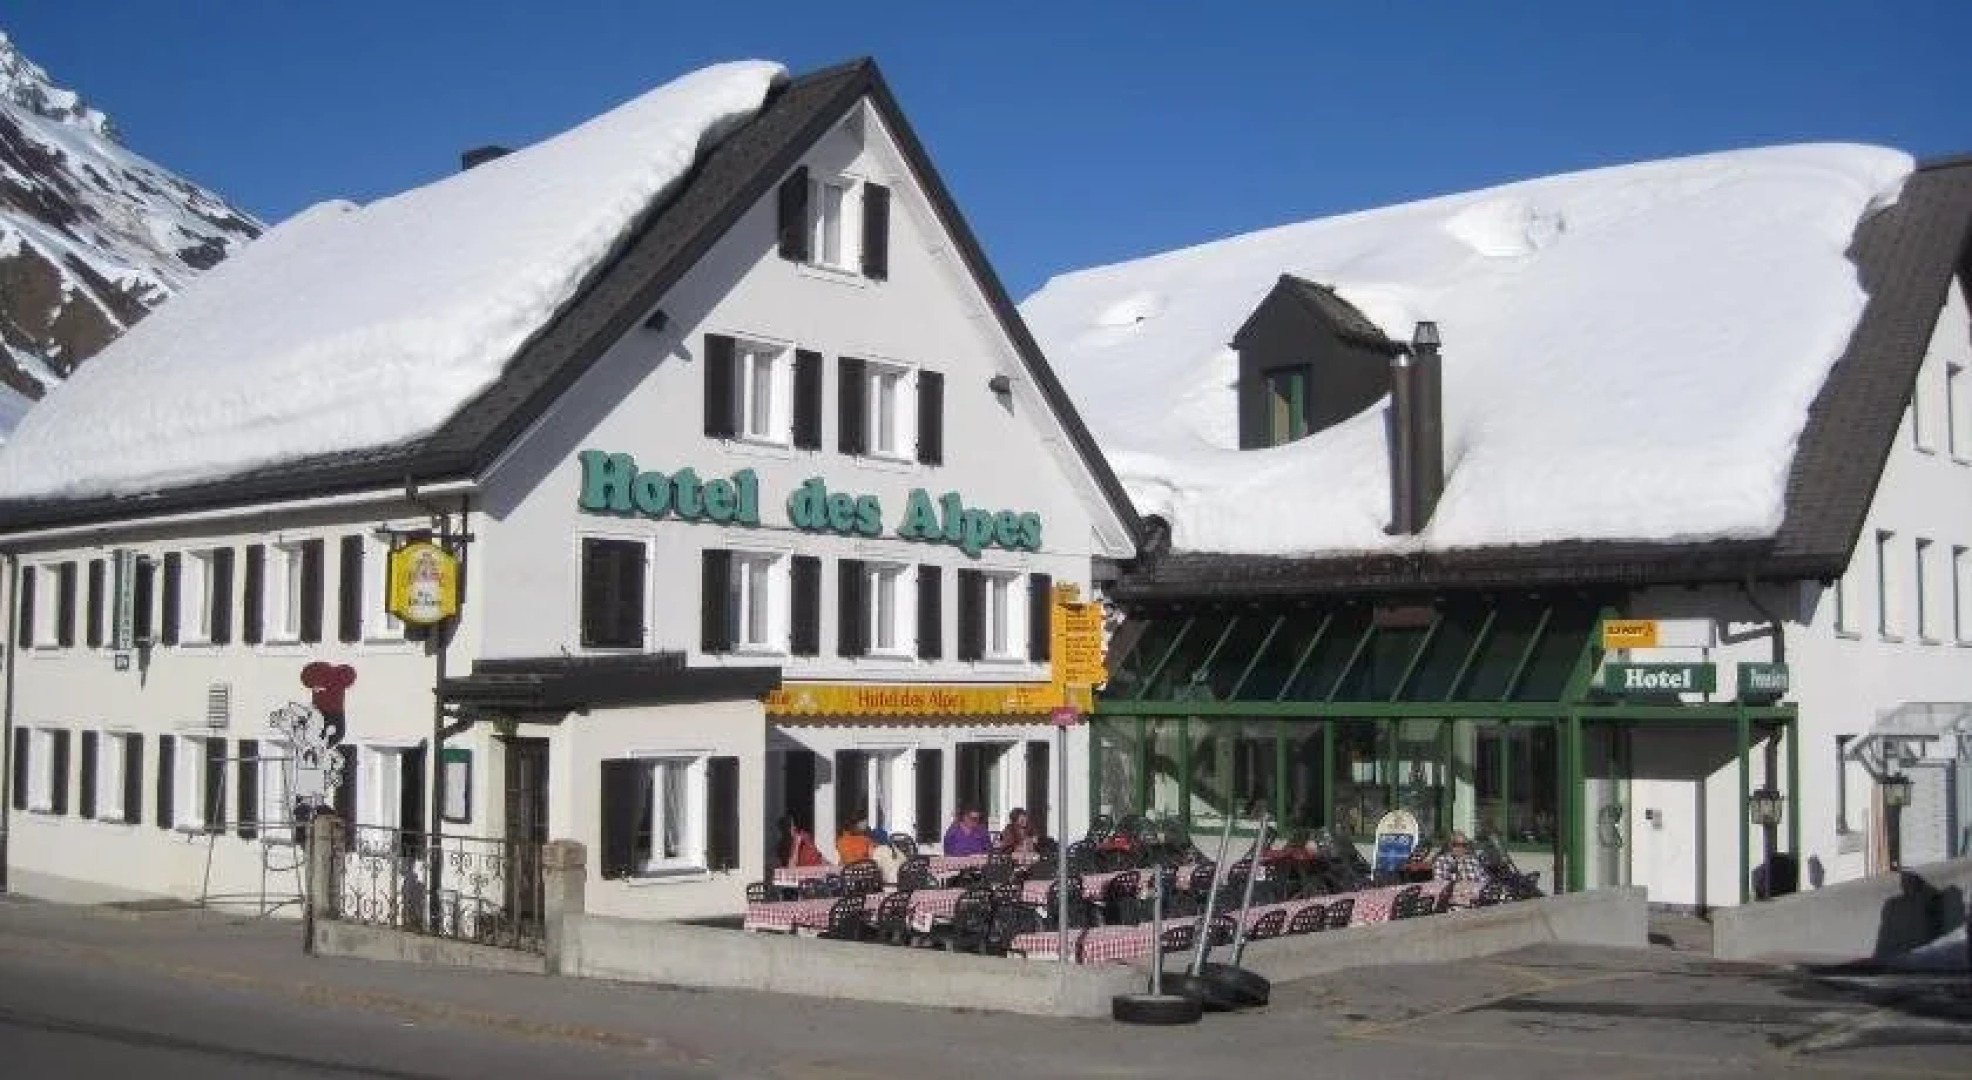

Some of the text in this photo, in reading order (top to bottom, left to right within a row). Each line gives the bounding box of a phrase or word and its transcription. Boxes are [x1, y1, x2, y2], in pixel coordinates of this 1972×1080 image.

[578, 449, 1043, 559] Hotel des Alpes
[1624, 668, 1692, 689] Hotel
[857, 688, 898, 708] Hotel
[900, 689, 926, 708] des
